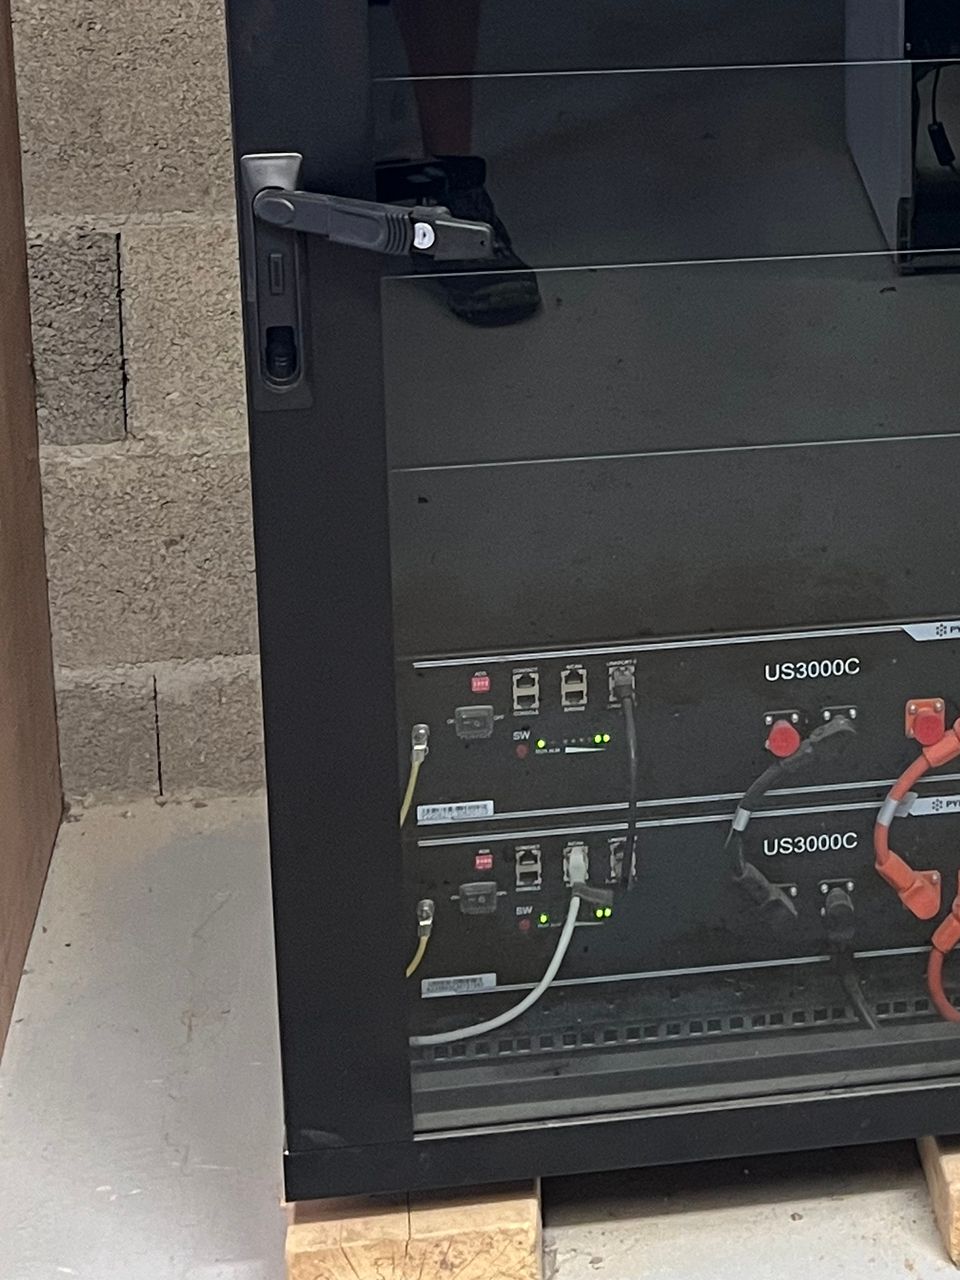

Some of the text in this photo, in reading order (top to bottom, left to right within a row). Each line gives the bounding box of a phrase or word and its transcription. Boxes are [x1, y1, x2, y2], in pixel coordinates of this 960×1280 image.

[764, 657, 860, 681] US3000C
[512, 730, 531, 741] SW
[763, 831, 858, 856] US3000C
